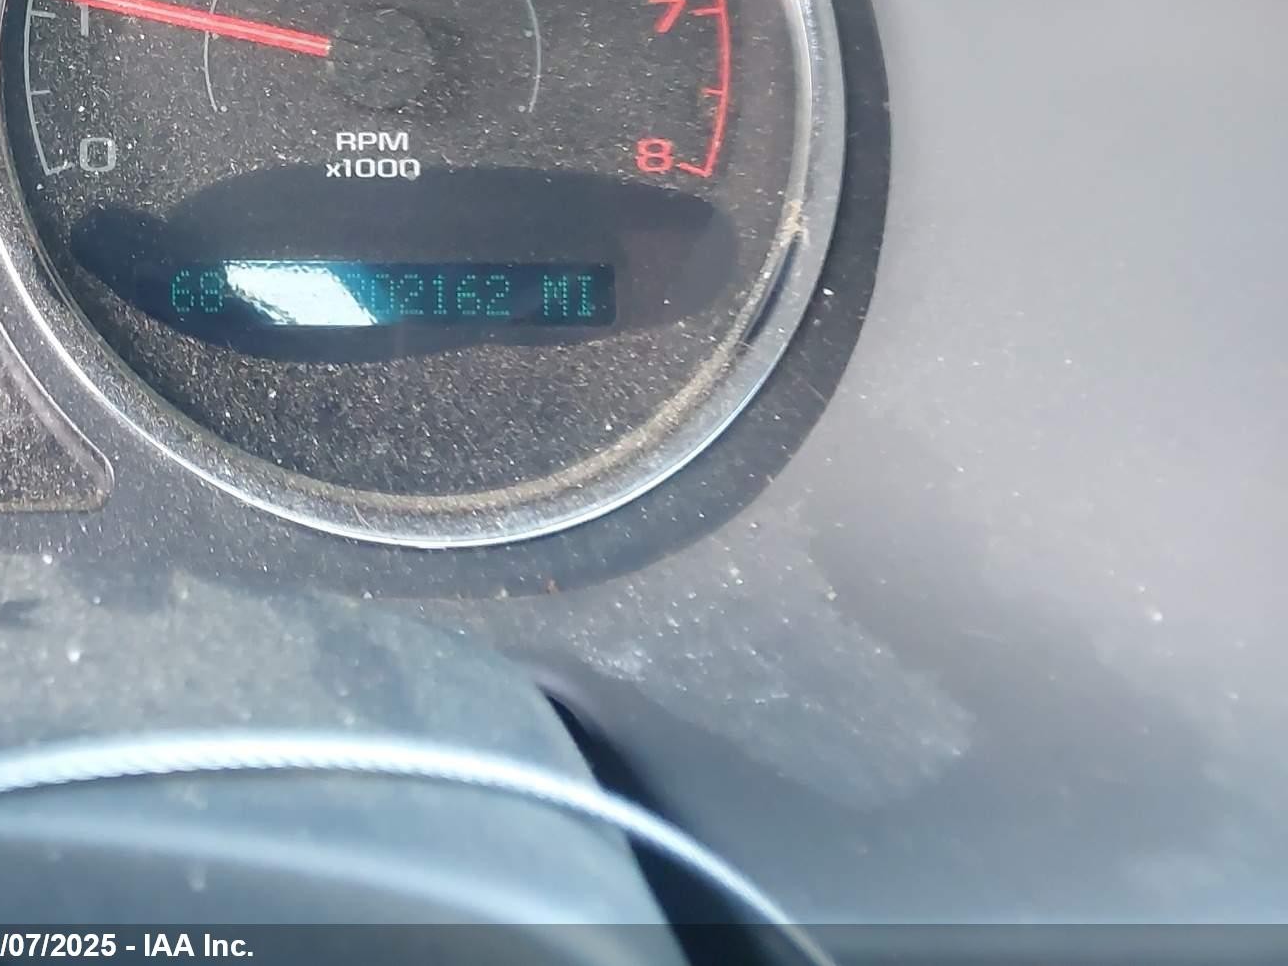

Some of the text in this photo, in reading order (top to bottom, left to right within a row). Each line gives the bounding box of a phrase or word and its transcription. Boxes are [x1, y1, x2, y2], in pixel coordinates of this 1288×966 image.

[80, 137, 116, 172] 0
[336, 132, 409, 151] RPM
[635, 138, 673, 173] 8
[325, 158, 420, 178] x1000
[172, 270, 225, 313] 68
[543, 274, 593, 317] MI
